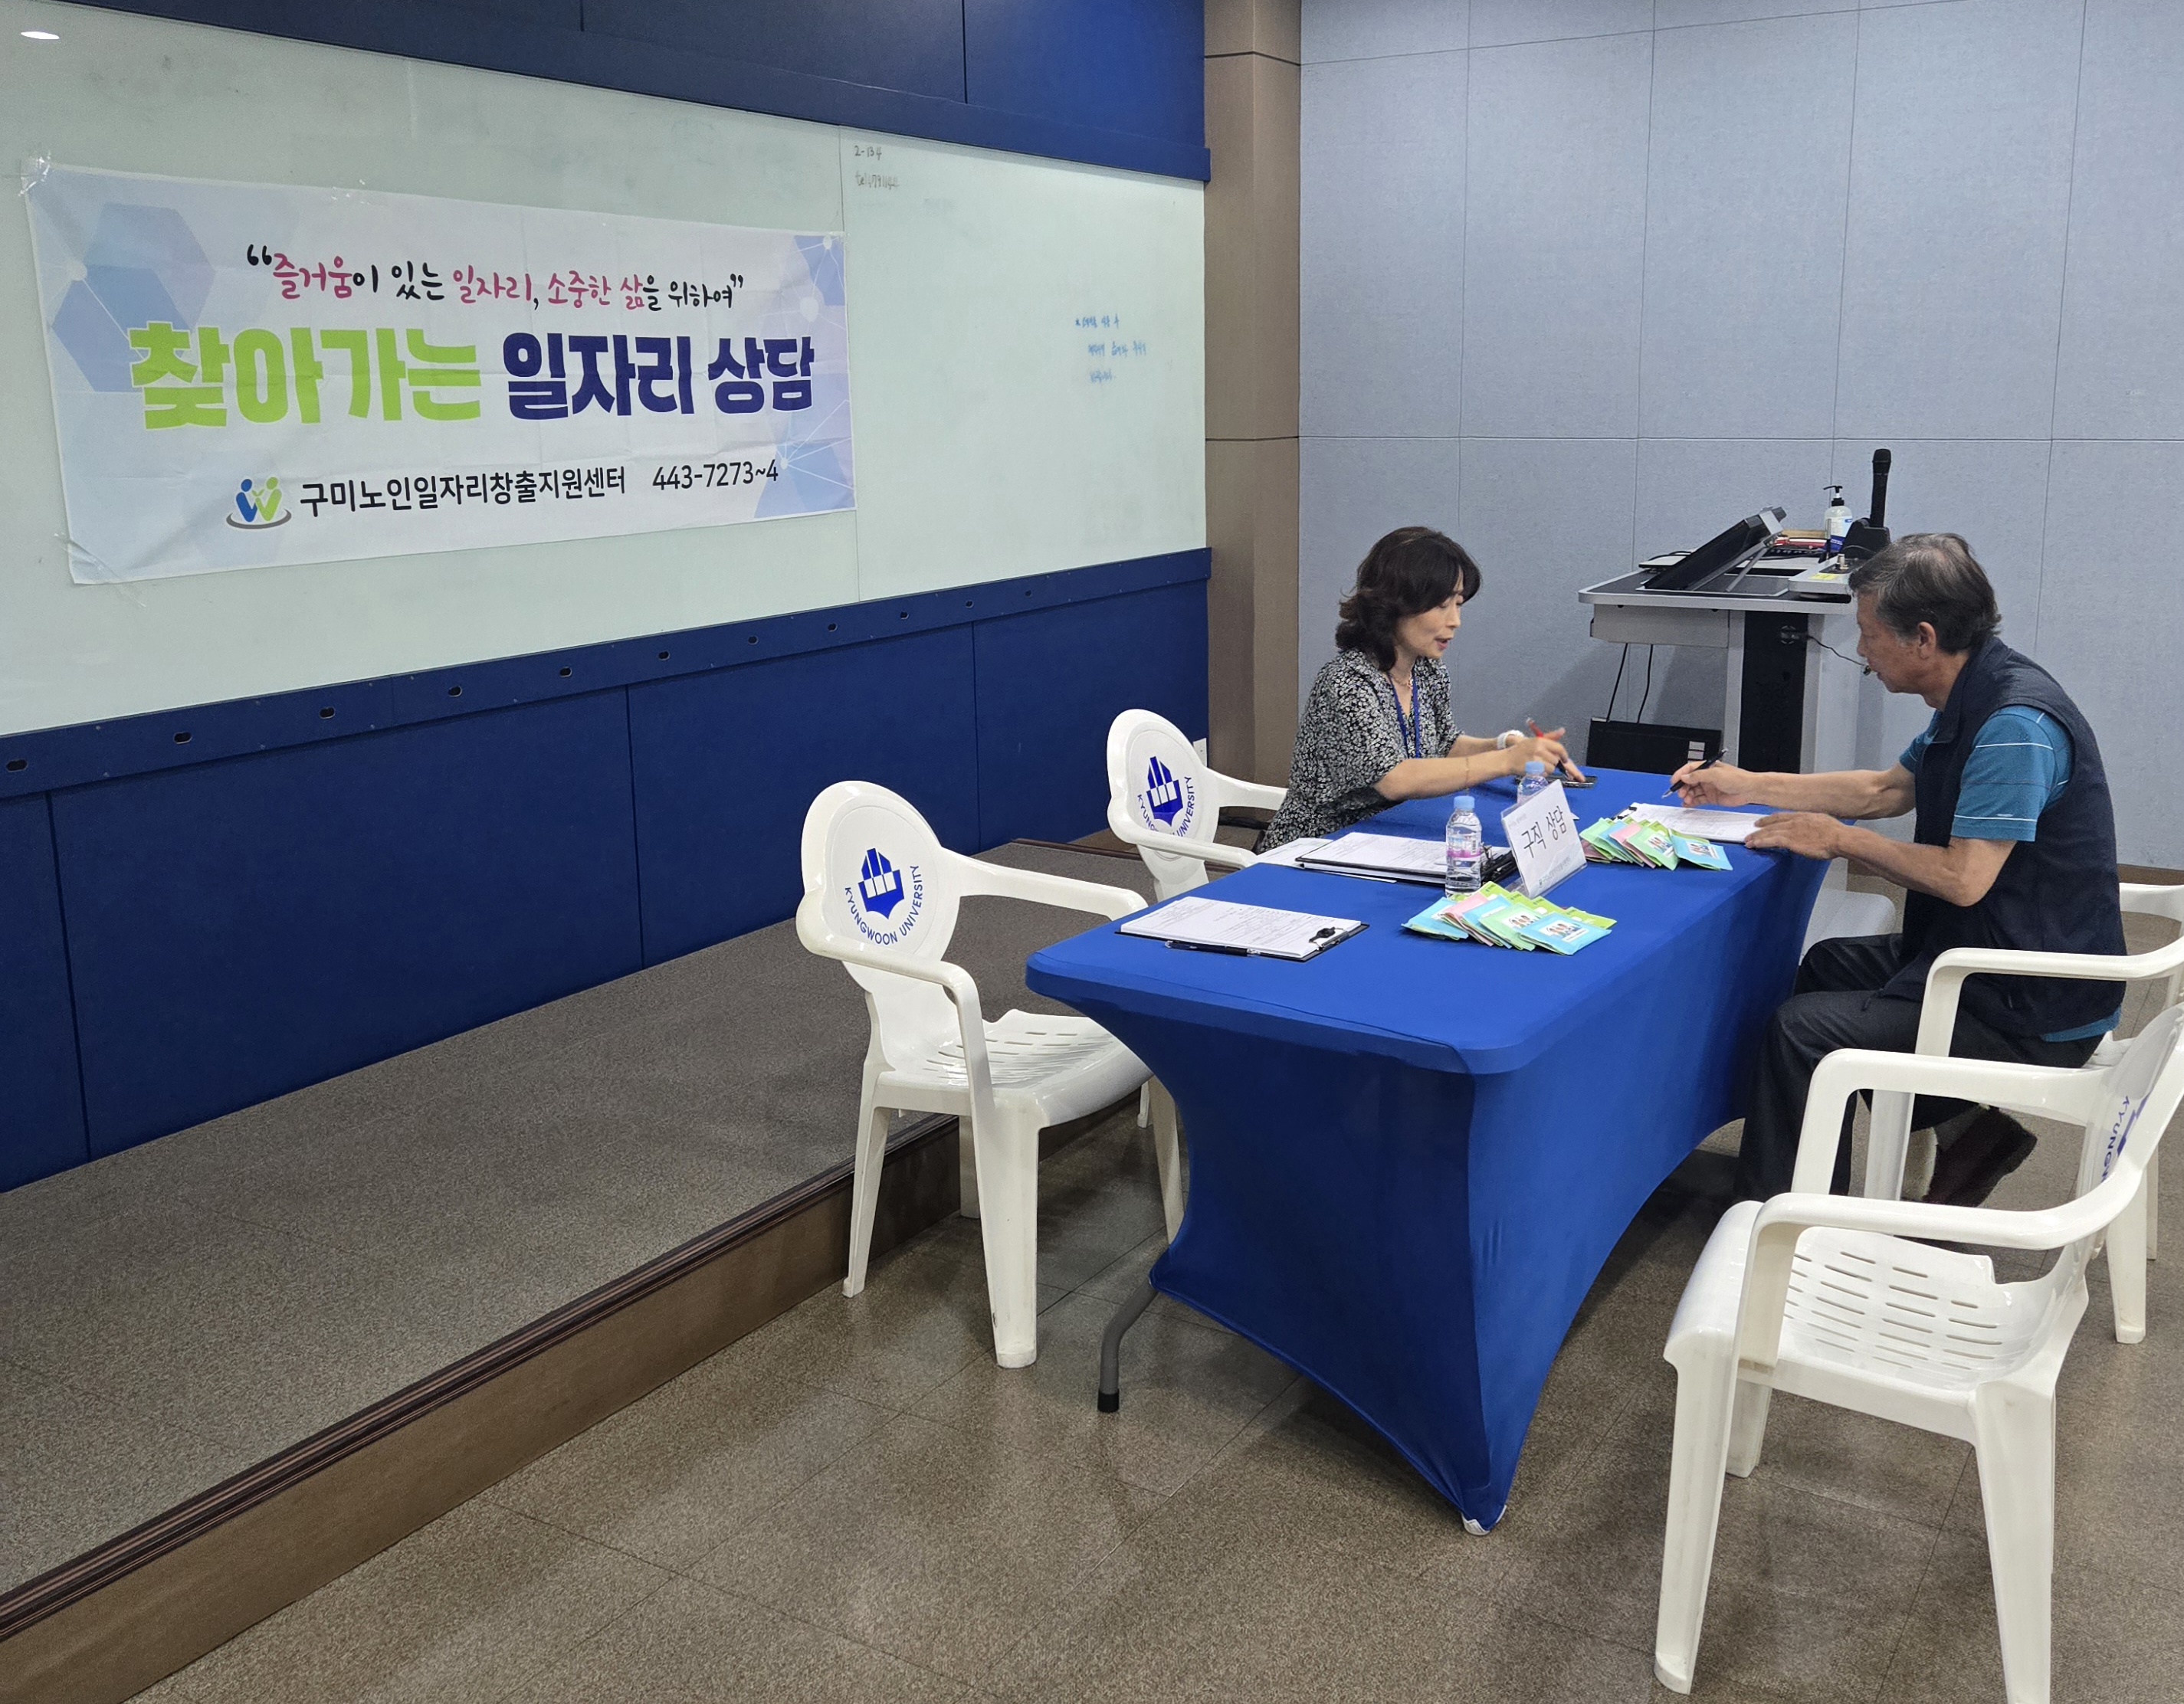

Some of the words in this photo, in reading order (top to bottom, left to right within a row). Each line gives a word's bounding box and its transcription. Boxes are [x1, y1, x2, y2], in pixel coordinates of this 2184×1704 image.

[392, 261, 445, 301] 있는
[452, 264, 539, 310] 일자리,
[548, 270, 612, 309] 소중한
[620, 274, 662, 312] 삶을
[128, 320, 482, 431] 찾아가는
[503, 331, 694, 421] 일자리
[707, 334, 815, 415] 상담
[300, 466, 627, 518] 구미노인일자리창출지원센터
[652, 458, 779, 491] 443-7273~4
[1521, 821, 1546, 859] 구직
[1546, 805, 1567, 841] 상담
[844, 886, 898, 945] KYUNGWOON
[898, 865, 923, 936] UNIVERSITY
